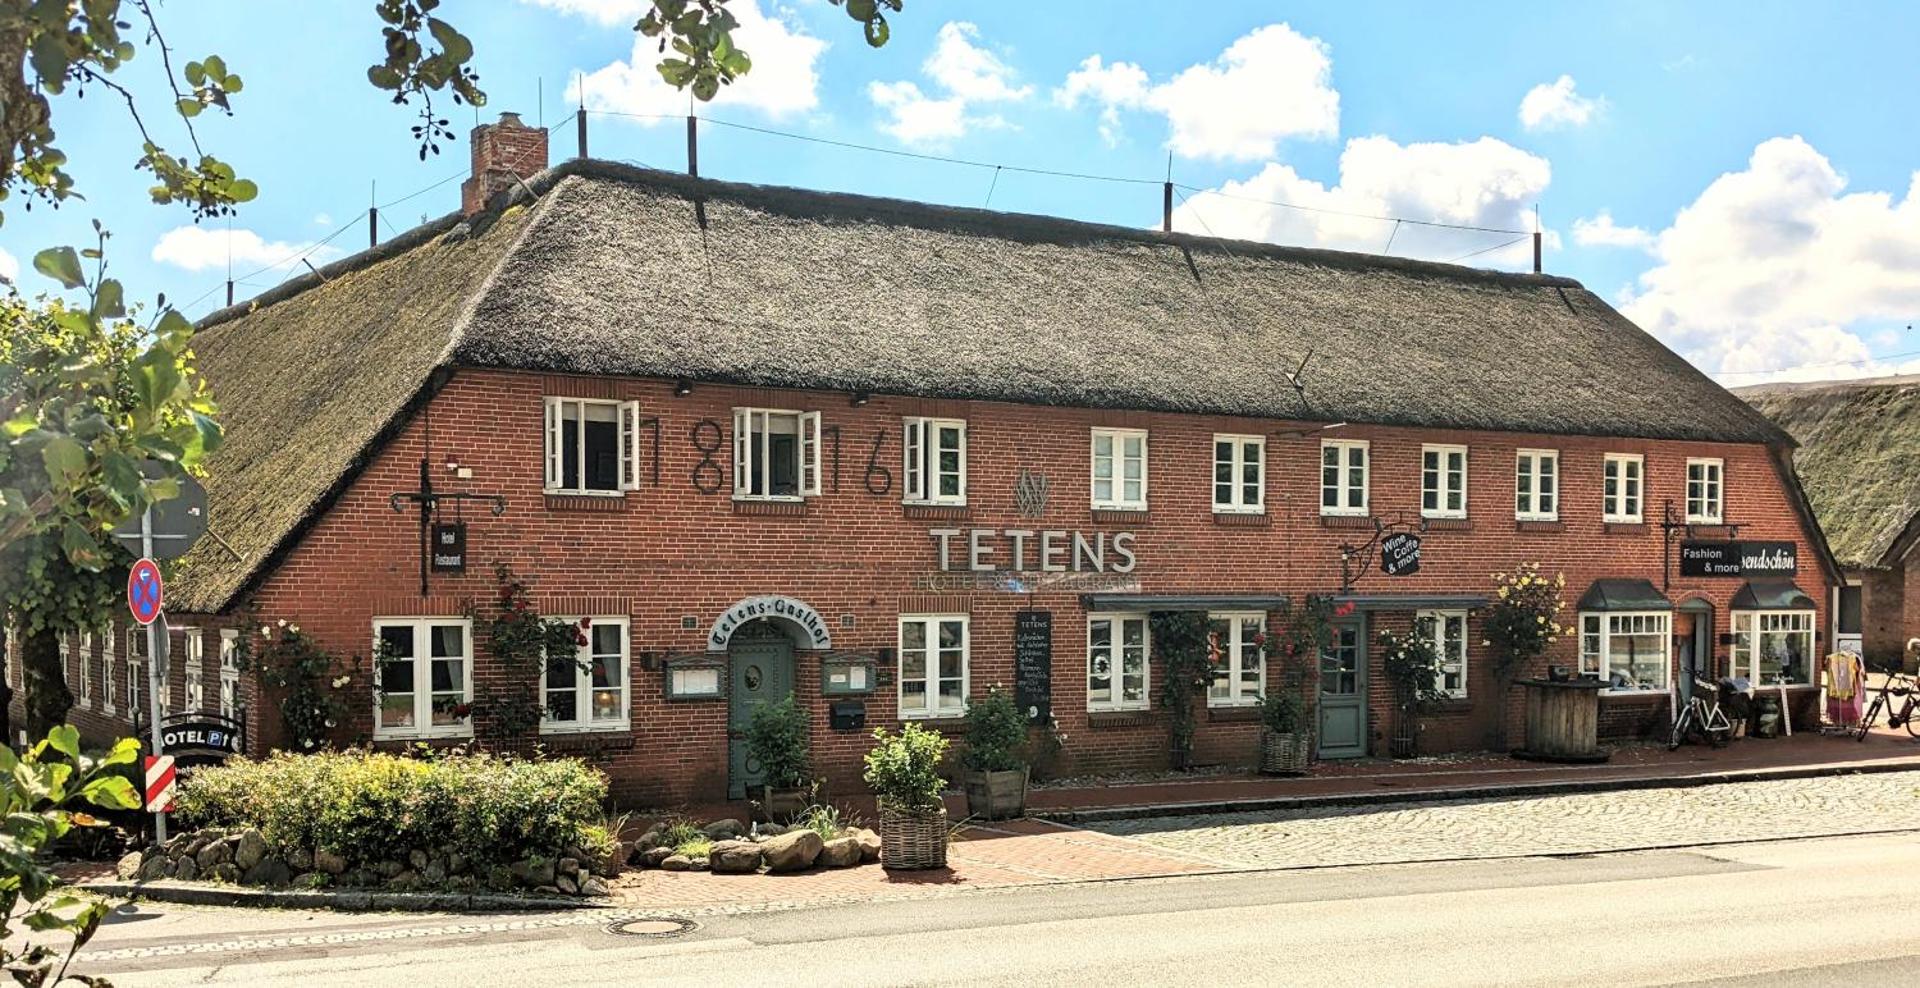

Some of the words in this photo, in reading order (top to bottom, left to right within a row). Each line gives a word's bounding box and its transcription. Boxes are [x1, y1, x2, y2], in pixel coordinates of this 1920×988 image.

[441, 531, 455, 545] Hotel
[1383, 535, 1406, 553] Wine
[929, 528, 1137, 574] TETENS
[1683, 548, 1723, 559] Fashion
[435, 553, 461, 566] Restaurant
[1389, 563, 1396, 573] &
[1397, 550, 1420, 568] more
[1704, 562, 1712, 573] &
[1714, 564, 1740, 573] more
[917, 575, 984, 590] HOTEL
